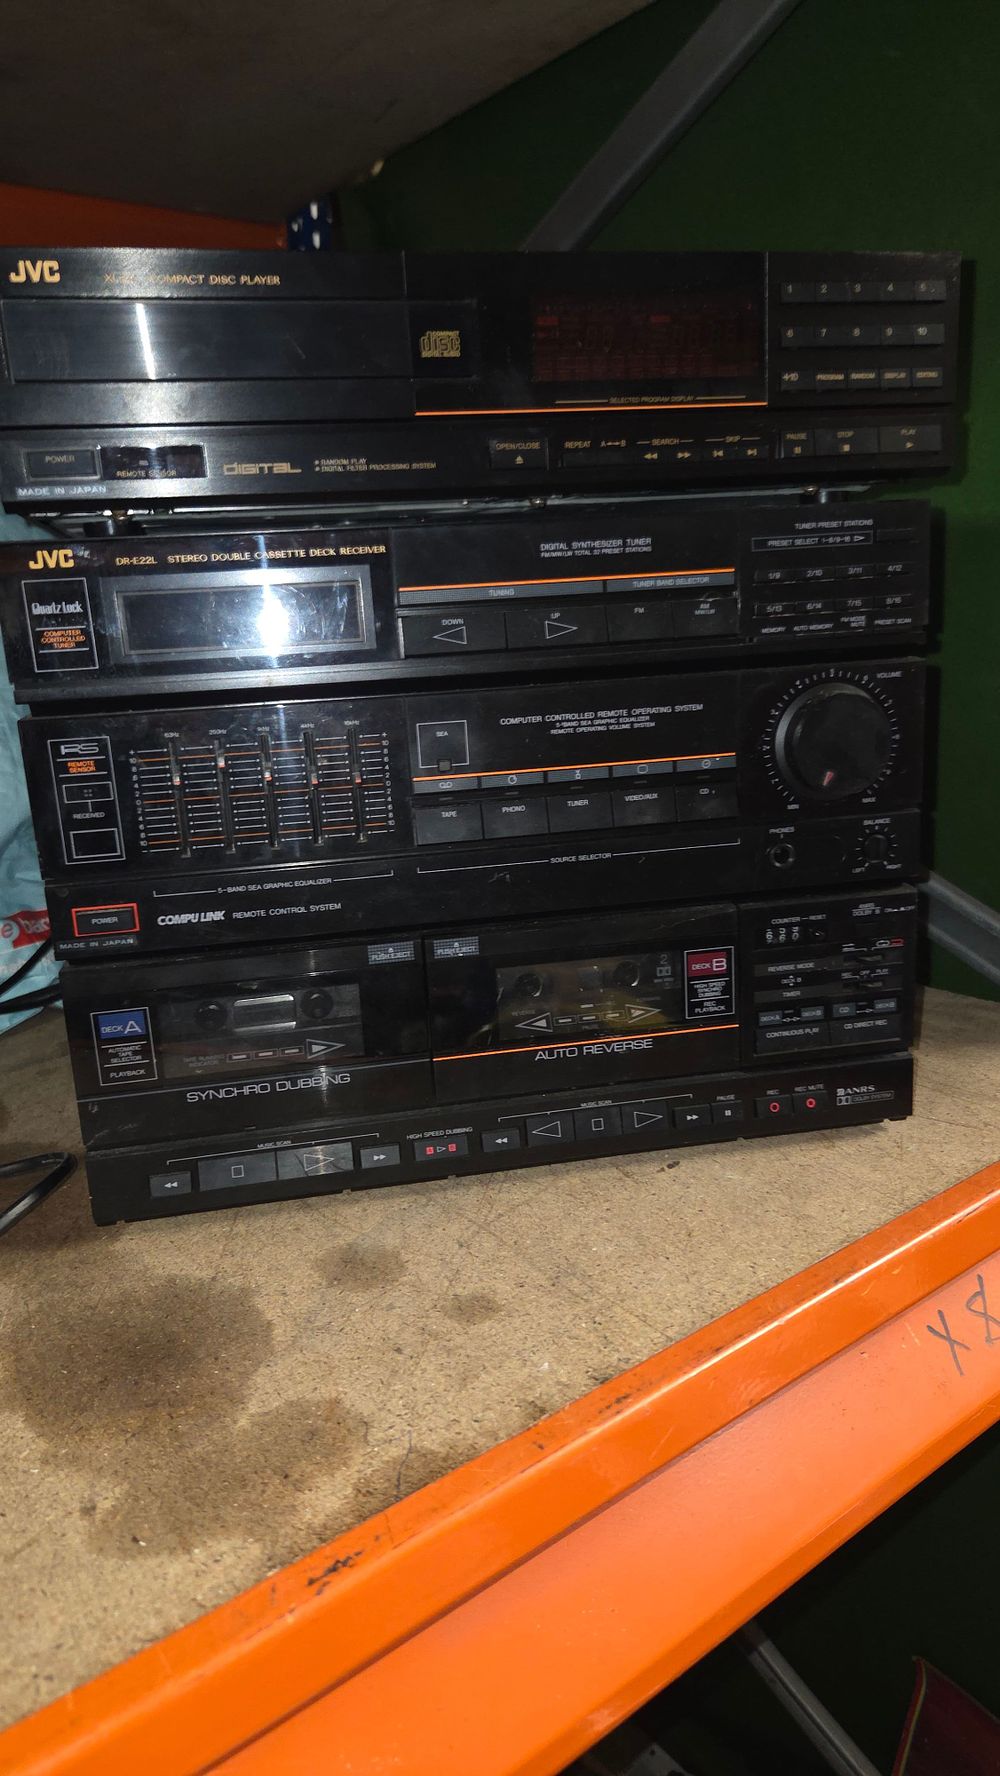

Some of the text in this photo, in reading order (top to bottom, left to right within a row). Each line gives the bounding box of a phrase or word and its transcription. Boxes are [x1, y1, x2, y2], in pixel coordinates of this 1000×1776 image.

[8, 259, 61, 284] JVC
[209, 274, 237, 286] DISC
[240, 275, 281, 286] PLAYER
[787, 283, 793, 294] 1
[820, 283, 828, 294] 2
[854, 282, 861, 293] 3
[887, 282, 894, 292] 4
[917, 326, 928, 336] 10
[495, 441, 541, 451] OPEN/CLOSE
[564, 439, 592, 449] REPEAT
[652, 438, 680, 447] SEARCH
[45, 454, 76, 465] POWER
[321, 457, 368, 466] RANDOM PLAY
[321, 465, 345, 473] DIGITAL
[369, 463, 410, 471] PROCESSING
[411, 461, 437, 470] SYSTEM
[116, 469, 146, 478] REMOTE
[16, 485, 107, 497] MADE IN JAPAN
[818, 521, 842, 529] PRESET
[844, 519, 873, 527] STATIONS
[540, 536, 652, 552] DIGITAL SYNTHESIZER TUNER
[768, 537, 819, 547] PRESET SELECT
[115, 545, 387, 566] DR-E22L STEREO DOUBLE CASSETTE DECK RECEIVER
[574, 549, 592, 557] TOTAL
[602, 547, 624, 555] PRESET
[28, 549, 75, 570] JVC
[807, 568, 823, 577] 2/10
[633, 576, 710, 588] TUNER BAND SELECTOR
[488, 587, 515, 597] TUNING
[62, 600, 84, 614] Lock
[634, 606, 645, 614] FM
[550, 612, 561, 620] UP
[441, 617, 465, 626] DOWN
[43, 629, 82, 637] COMPUTER
[41, 635, 86, 644] CONTROLLED
[876, 670, 903, 679] VOLUME
[500, 703, 704, 726] COMPUTER CONTROLLED REMOTE OPERATING SYSTEM
[550, 721, 656, 736] REMOTE OPERATING VOLUME SYSTEM
[67, 760, 95, 768] REMOTE
[68, 766, 97, 774] SENSOR
[625, 793, 659, 802] VIDEO/AUX
[567, 799, 589, 807] TUNER
[502, 804, 526, 813] PHONO
[72, 811, 106, 820] RECEIVED
[441, 810, 458, 818] TAPE
[550, 852, 612, 864] SOURCE SELECTOR
[217, 878, 333, 895] 5-BAND SEA GRAPHIC EQUALIZER
[232, 902, 342, 920] REMOTE CONTROL SYSTEM
[91, 916, 119, 925] POWER
[157, 910, 226, 926] COMPU LINK
[771, 916, 801, 925] COUNTER
[59, 938, 134, 950] MADE IN JAPAN
[691, 957, 727, 971] DECK B
[768, 962, 815, 972] REVERSE MODE
[694, 1005, 726, 1014] PLAYBACK
[101, 1020, 142, 1035] DECK A
[766, 1027, 820, 1039] CONTINUOUS PLAY
[108, 1045, 142, 1054] AUTOMATIC
[535, 1038, 654, 1061] AUTO REVERSE
[109, 1069, 147, 1079] PLAYBACK
[186, 1072, 351, 1103] SYNCHRO DUBBING
[406, 1126, 473, 1141] HIGH SPEED DUBBING
[256, 1139, 292, 1149] MUSIC SCAN
